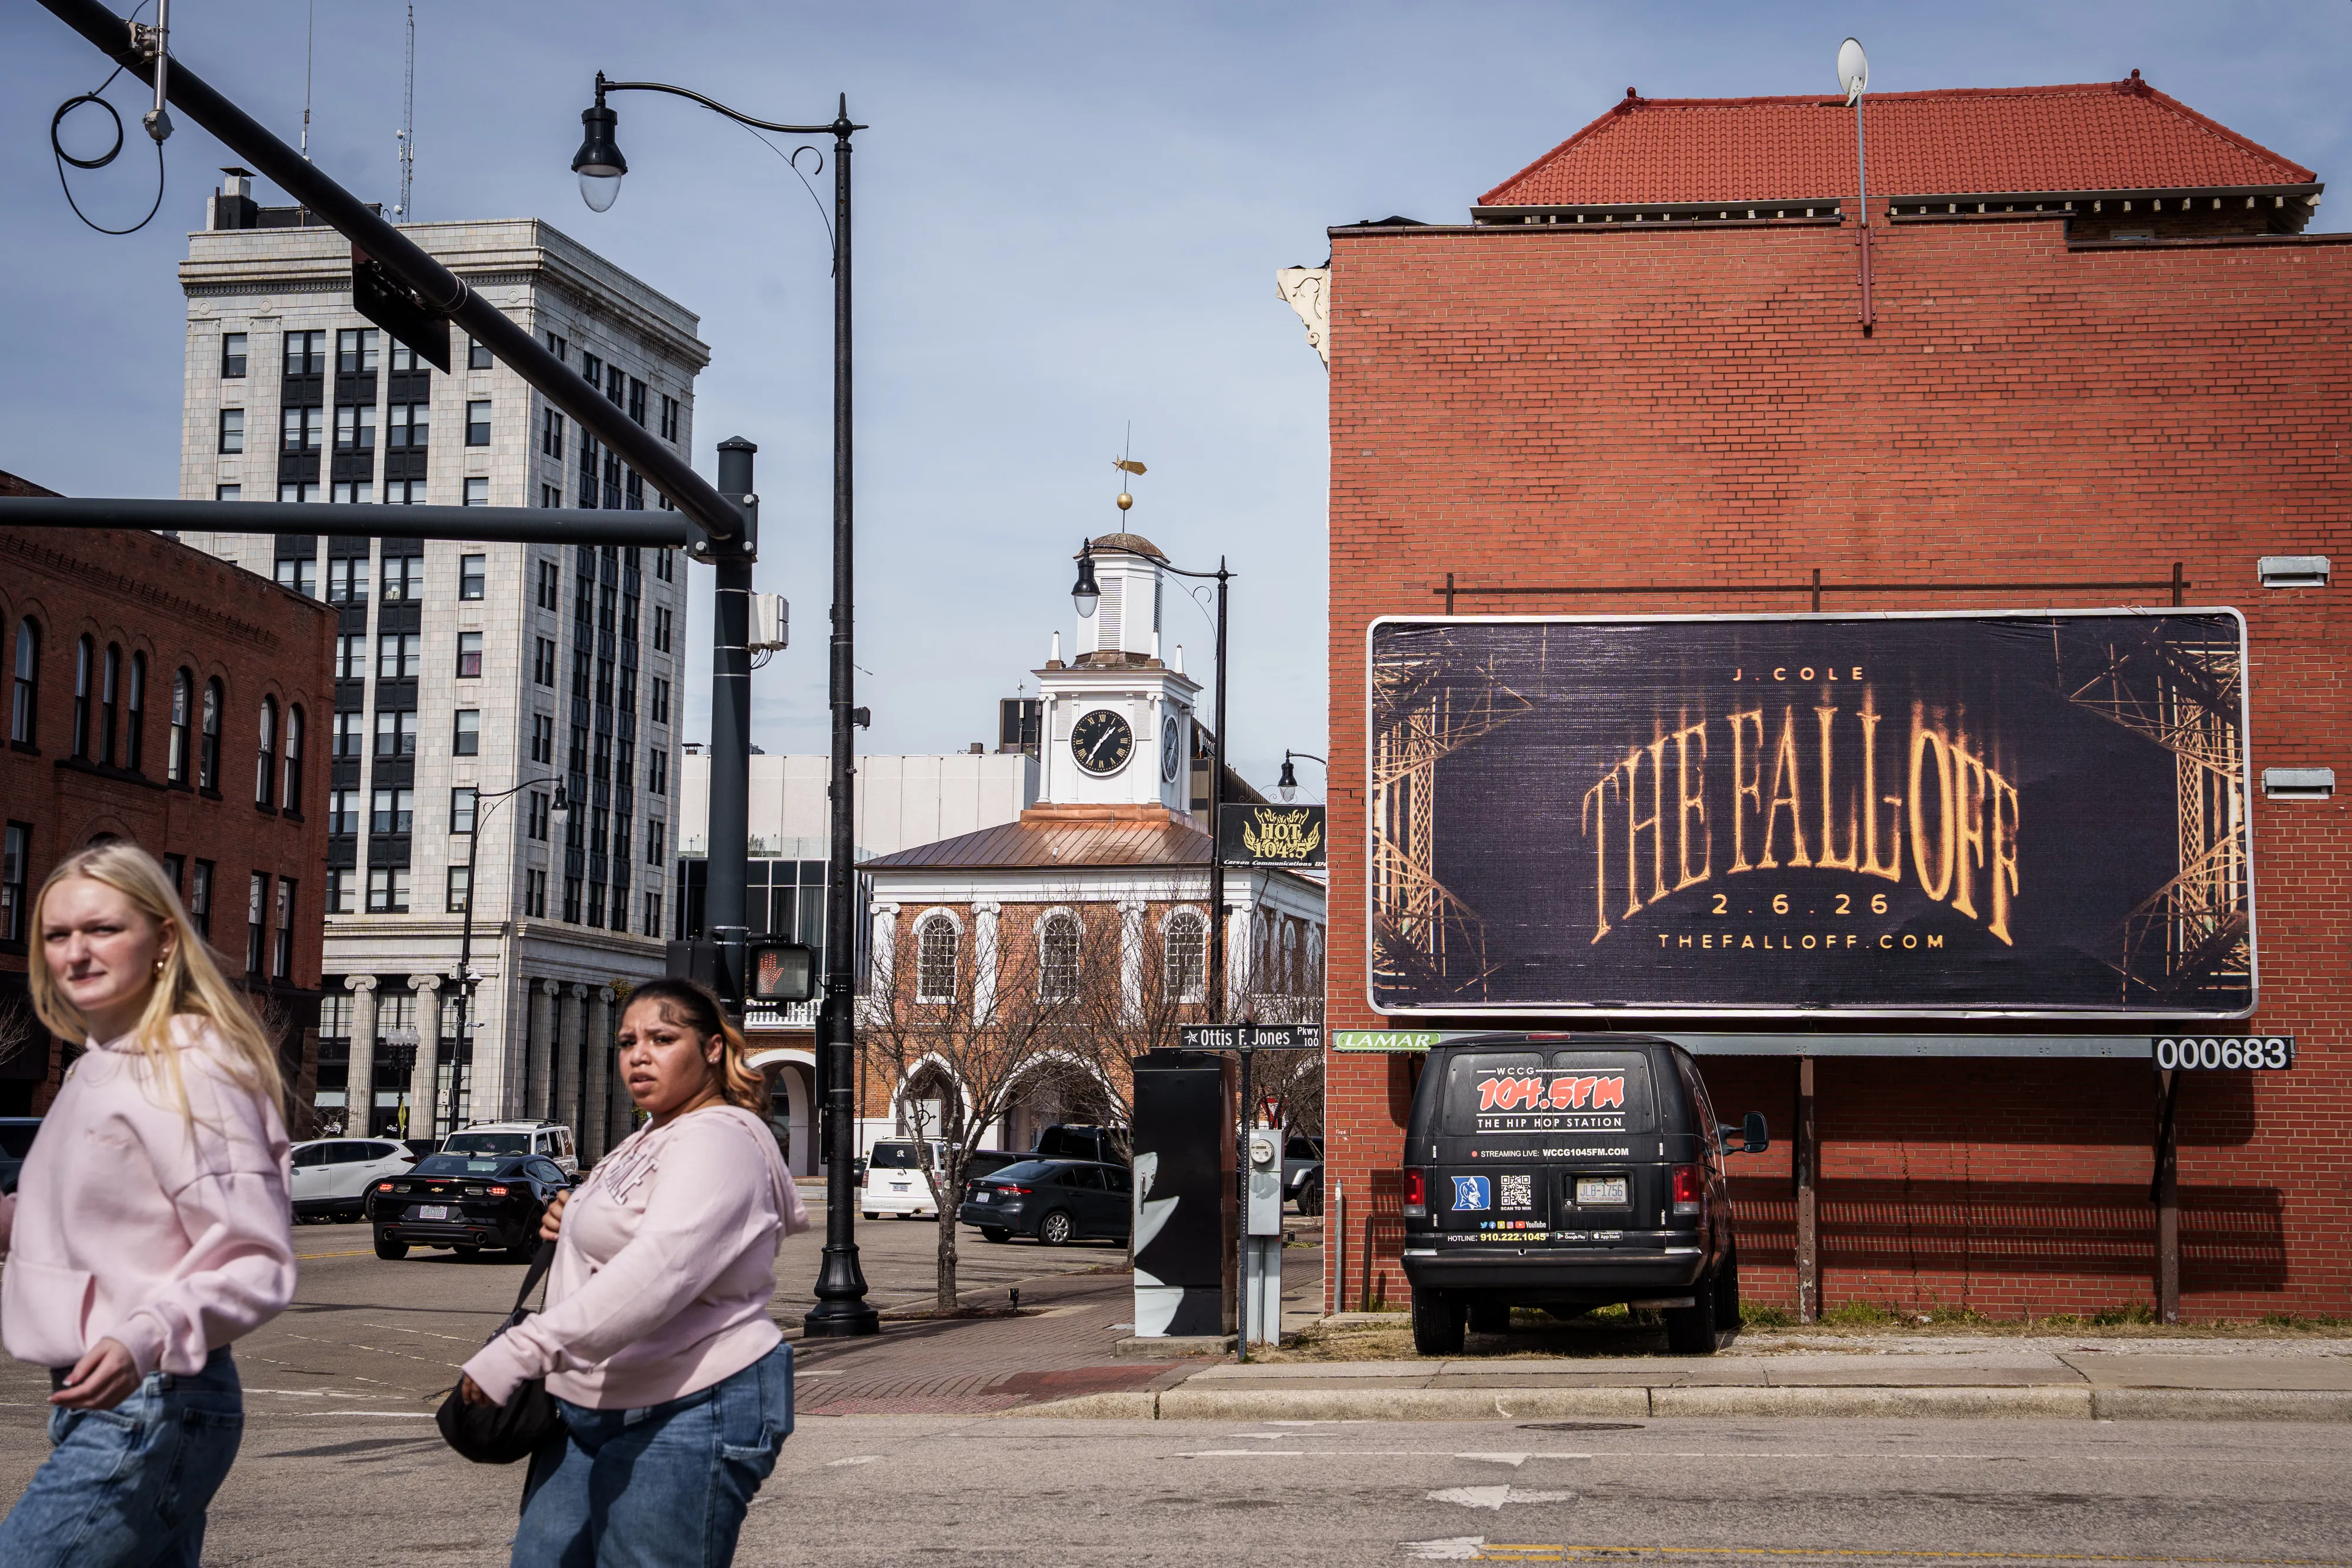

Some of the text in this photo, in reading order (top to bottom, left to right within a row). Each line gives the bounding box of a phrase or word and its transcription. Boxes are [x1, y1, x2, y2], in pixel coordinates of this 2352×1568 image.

[1260, 823, 1302, 840] HOT
[1582, 721, 1712, 945] THE
[1253, 841, 1307, 858] 104.5
[1659, 934, 1944, 950] THEFALLOFF.COM
[1201, 1028, 1291, 1046] Ottis F. Jones
[1297, 1027, 1318, 1037] Pkwy
[1304, 1037, 1319, 1047] 100
[1345, 1034, 1430, 1047] LAMAR
[2157, 1038, 2286, 1069] 000683
[1496, 1067, 1535, 1075] WCCG
[1476, 1076, 1625, 1111] 104.5FM
[1478, 1117, 1622, 1128] THE HIP HOP STATION
[1542, 1148, 1629, 1156] WCCG1045FM.COM
[1580, 1184, 1623, 1197] JLB-1756
[1481, 1233, 1546, 1242] 910.222.1045
